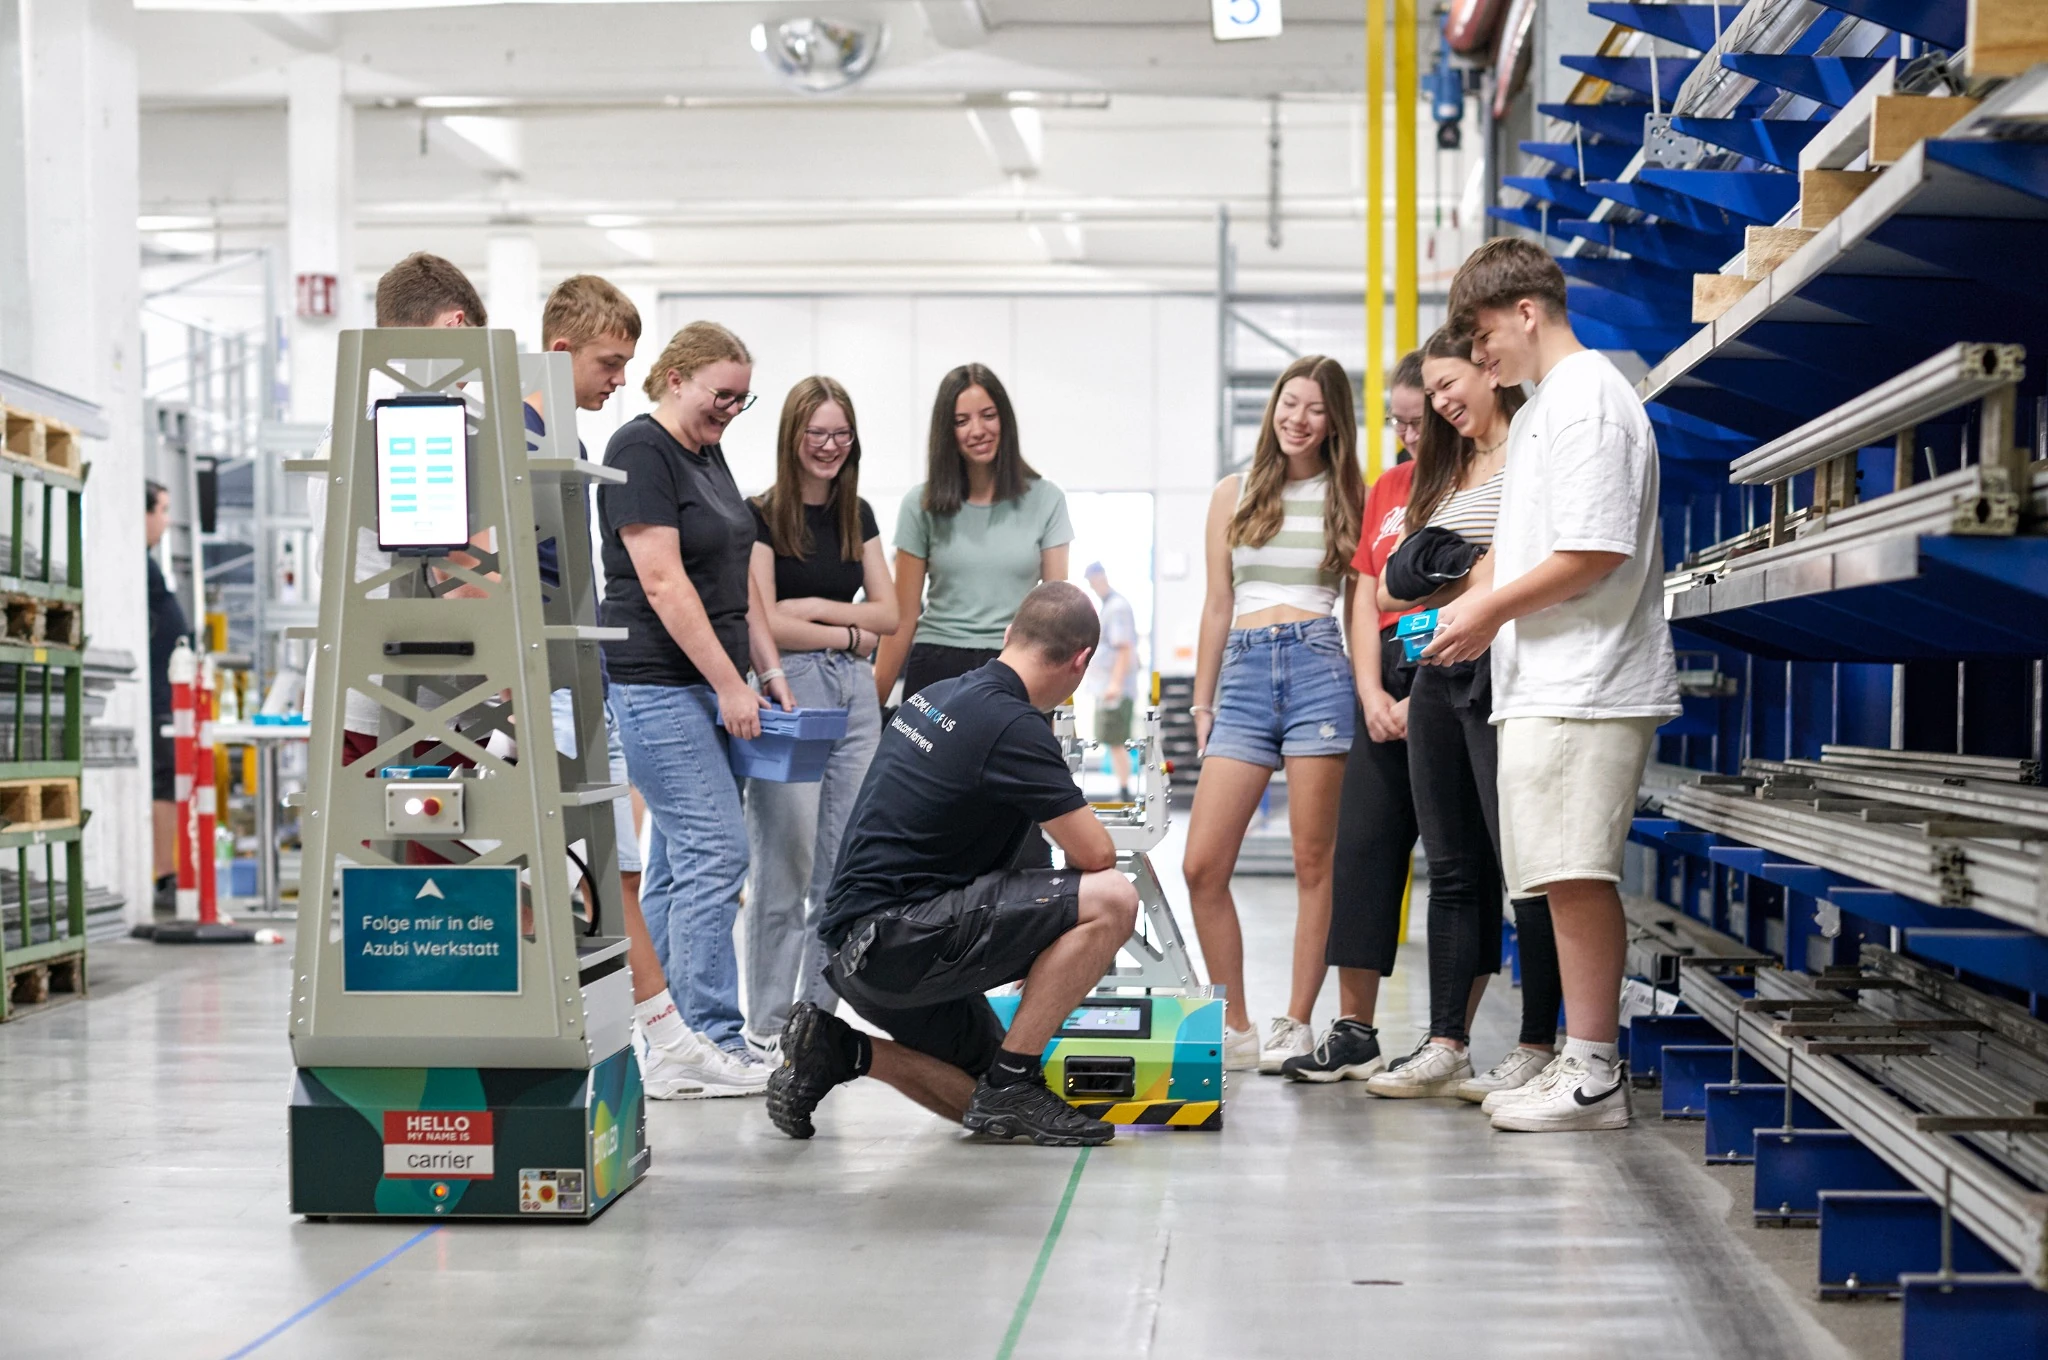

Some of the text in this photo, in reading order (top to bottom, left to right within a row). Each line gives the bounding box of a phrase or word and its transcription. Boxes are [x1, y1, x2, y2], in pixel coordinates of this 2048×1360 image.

[941, 716, 957, 732] US
[362, 915, 494, 934] Folge mir in die
[362, 941, 500, 956] Azubi Werkstatt
[406, 1116, 470, 1132] HELLO
[407, 1132, 470, 1141] MY NAME IS
[407, 1151, 474, 1169] carrier
